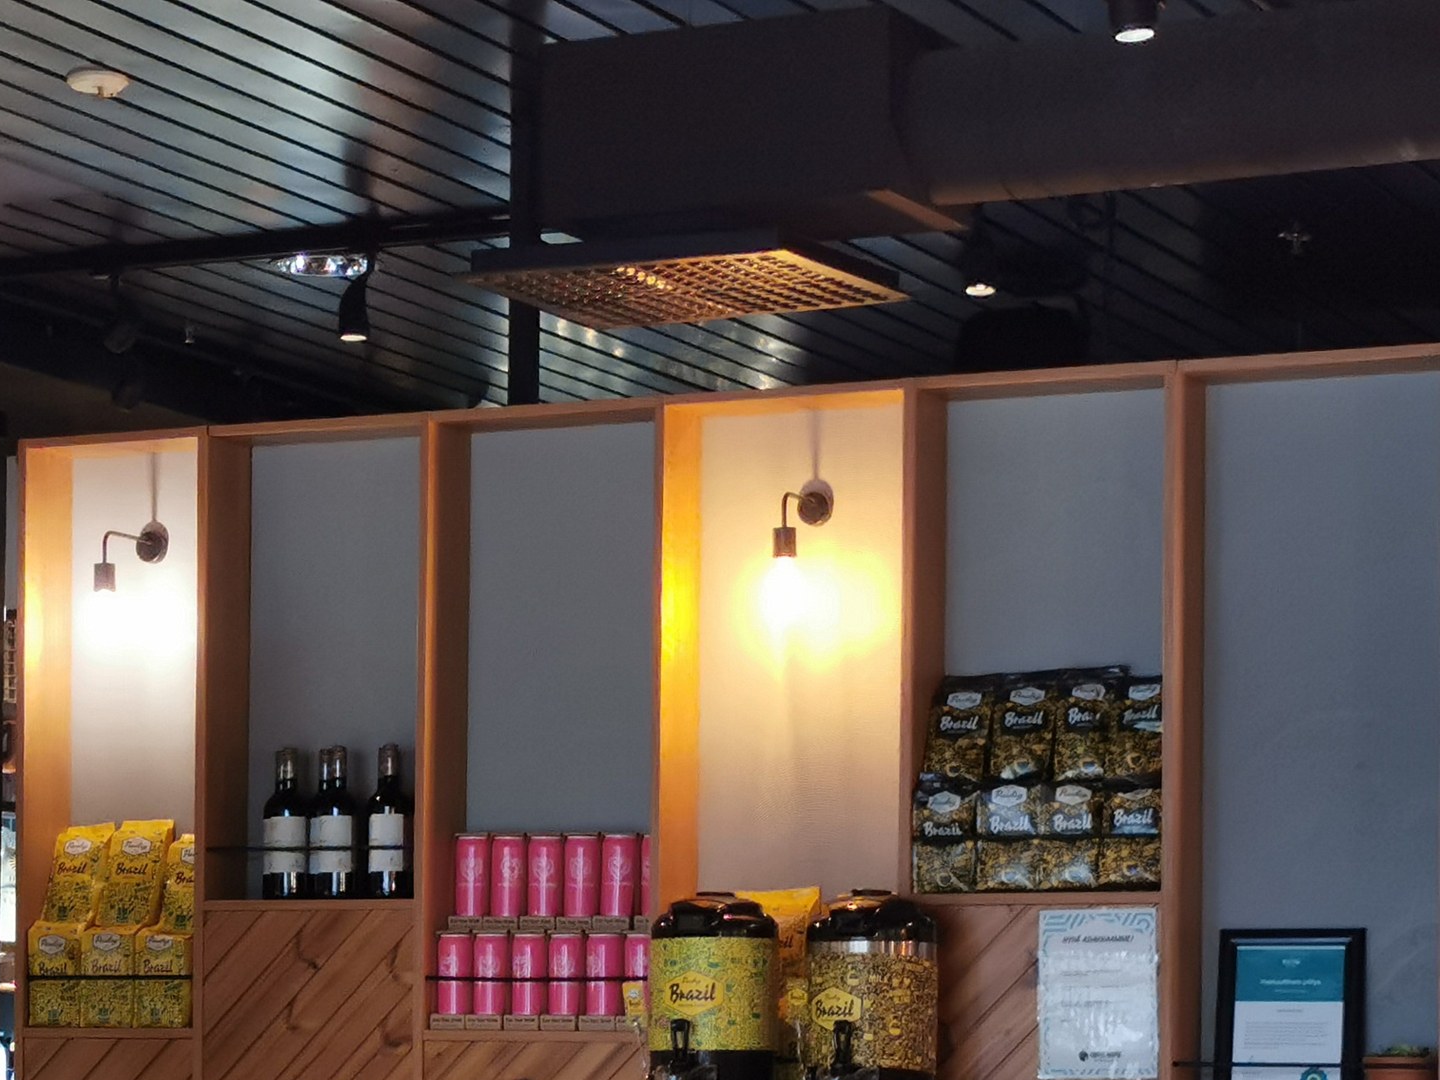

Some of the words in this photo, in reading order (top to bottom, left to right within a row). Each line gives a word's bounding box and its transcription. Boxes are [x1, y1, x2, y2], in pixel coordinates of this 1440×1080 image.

[940, 716, 978, 731] Brazil
[1004, 711, 1044, 727] Brazil
[989, 815, 1032, 833] Brazil
[1053, 814, 1092, 832] Brazil
[1114, 808, 1153, 825] Brazil
[57, 862, 89, 874] Brazil
[115, 861, 148, 876] Brazil
[91, 959, 122, 973] Brazil
[143, 959, 173, 973] Brazil
[669, 983, 716, 1004] Brazil
[815, 1000, 855, 1018] Brazil
